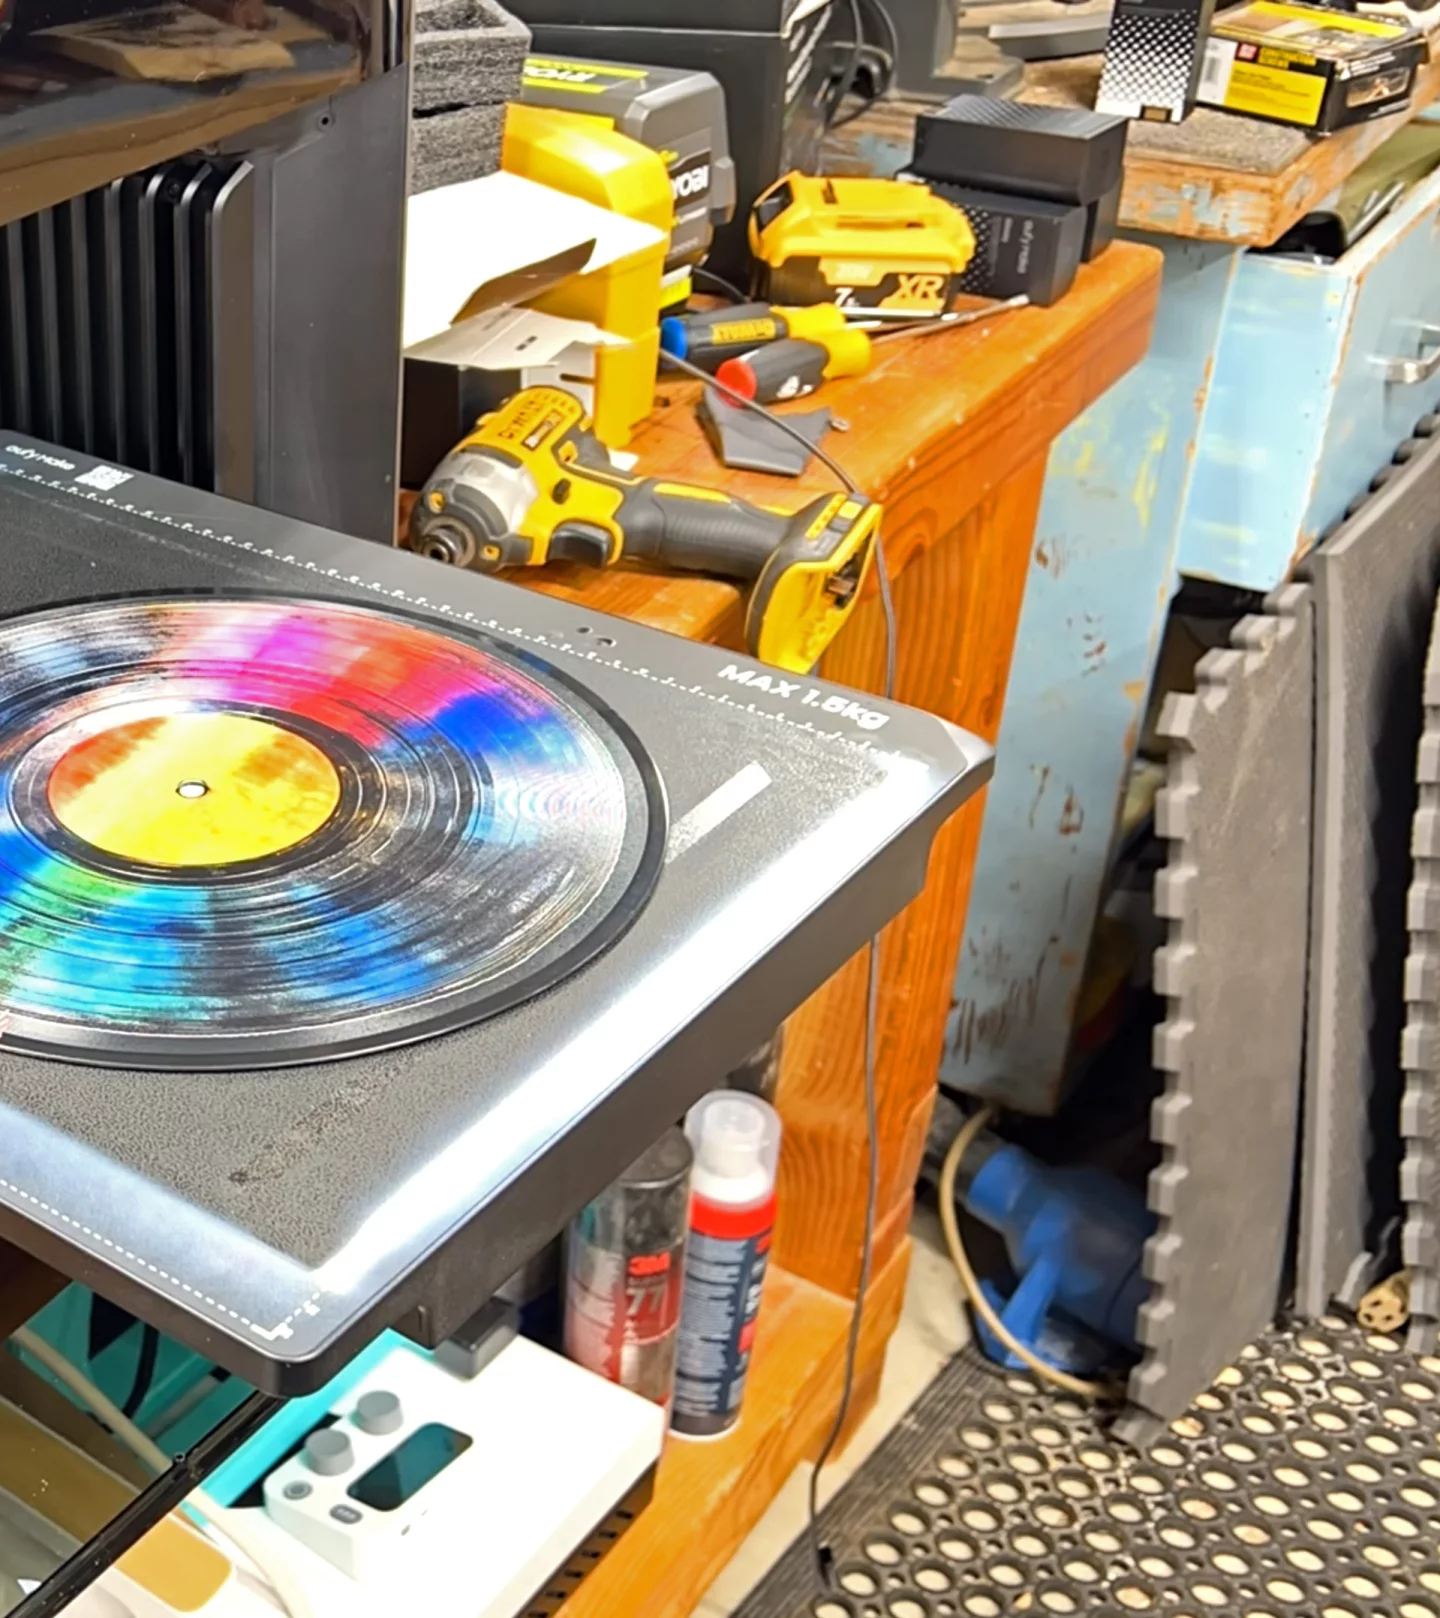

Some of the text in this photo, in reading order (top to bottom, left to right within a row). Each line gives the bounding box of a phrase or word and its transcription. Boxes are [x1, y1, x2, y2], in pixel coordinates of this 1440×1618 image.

[897, 273, 944, 301] XR
[717, 664, 891, 730] MAX 1.5kg
